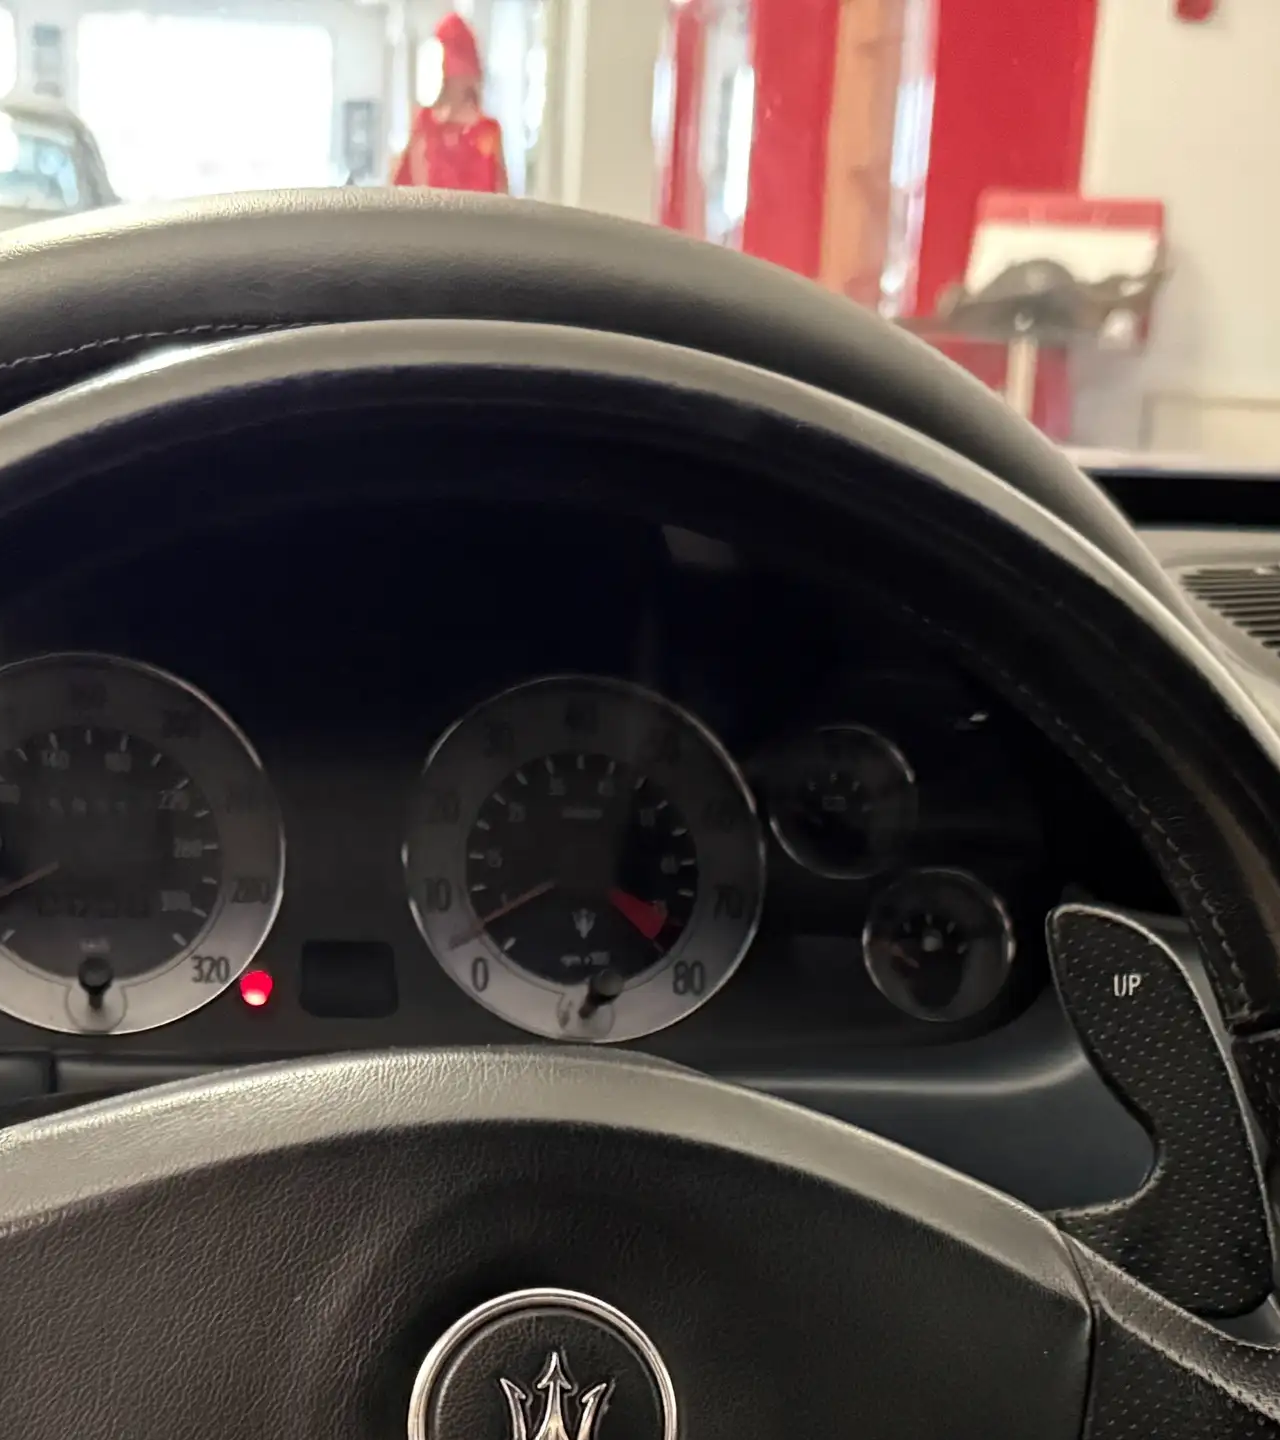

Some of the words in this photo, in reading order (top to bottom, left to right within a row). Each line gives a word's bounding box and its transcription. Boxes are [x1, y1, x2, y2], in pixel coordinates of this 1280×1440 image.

[190, 954, 232, 984] 320
[471, 956, 489, 993] 0
[672, 959, 706, 996] 80
[1113, 973, 1142, 997] UP
